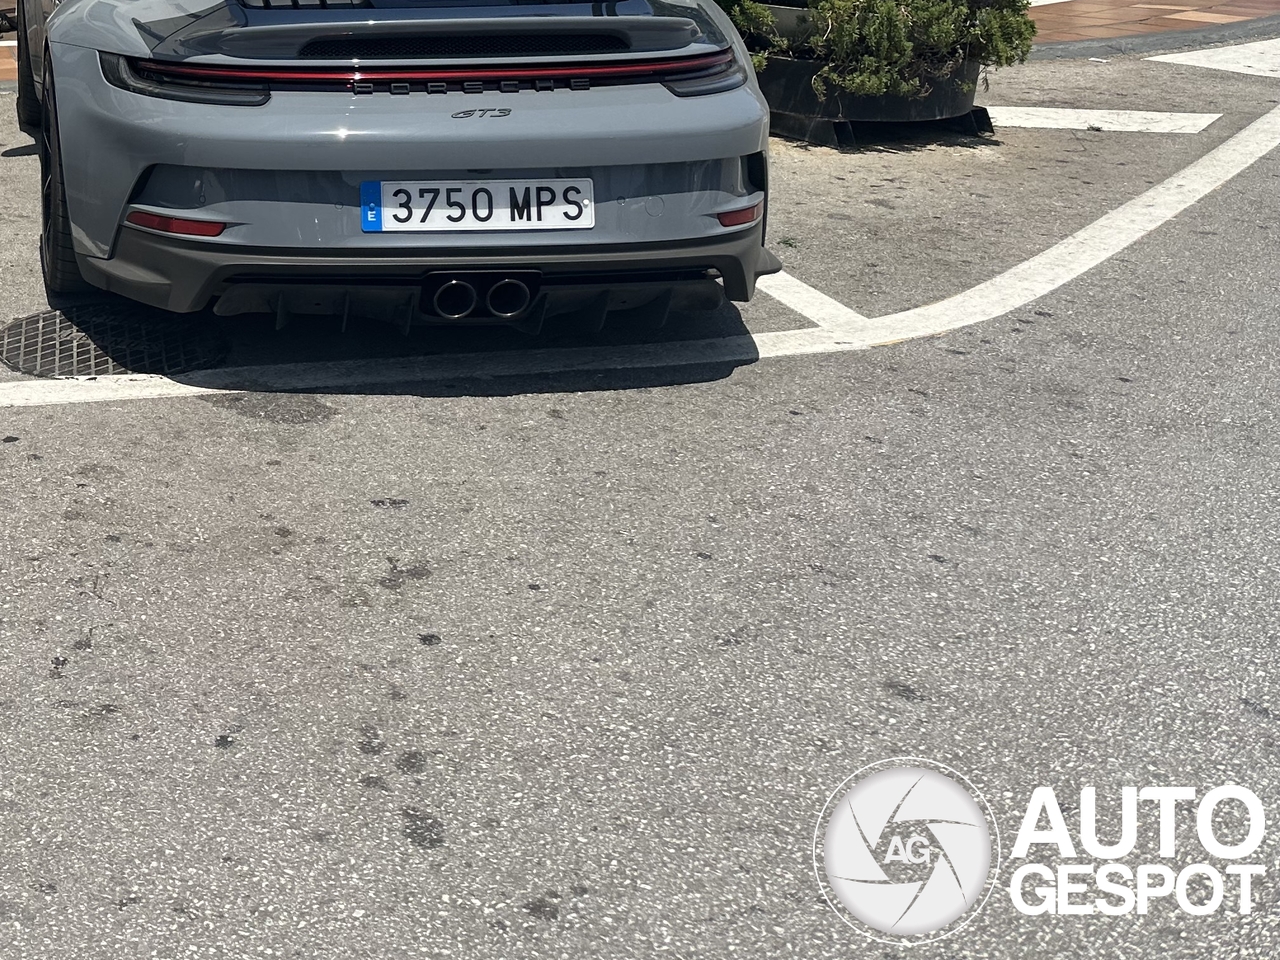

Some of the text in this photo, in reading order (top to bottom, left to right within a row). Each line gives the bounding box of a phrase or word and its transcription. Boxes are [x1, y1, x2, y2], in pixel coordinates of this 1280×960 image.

[353, 78, 591, 95] PORSCHE
[451, 107, 512, 119] GT3
[367, 185, 584, 224] E 3750 MPS
